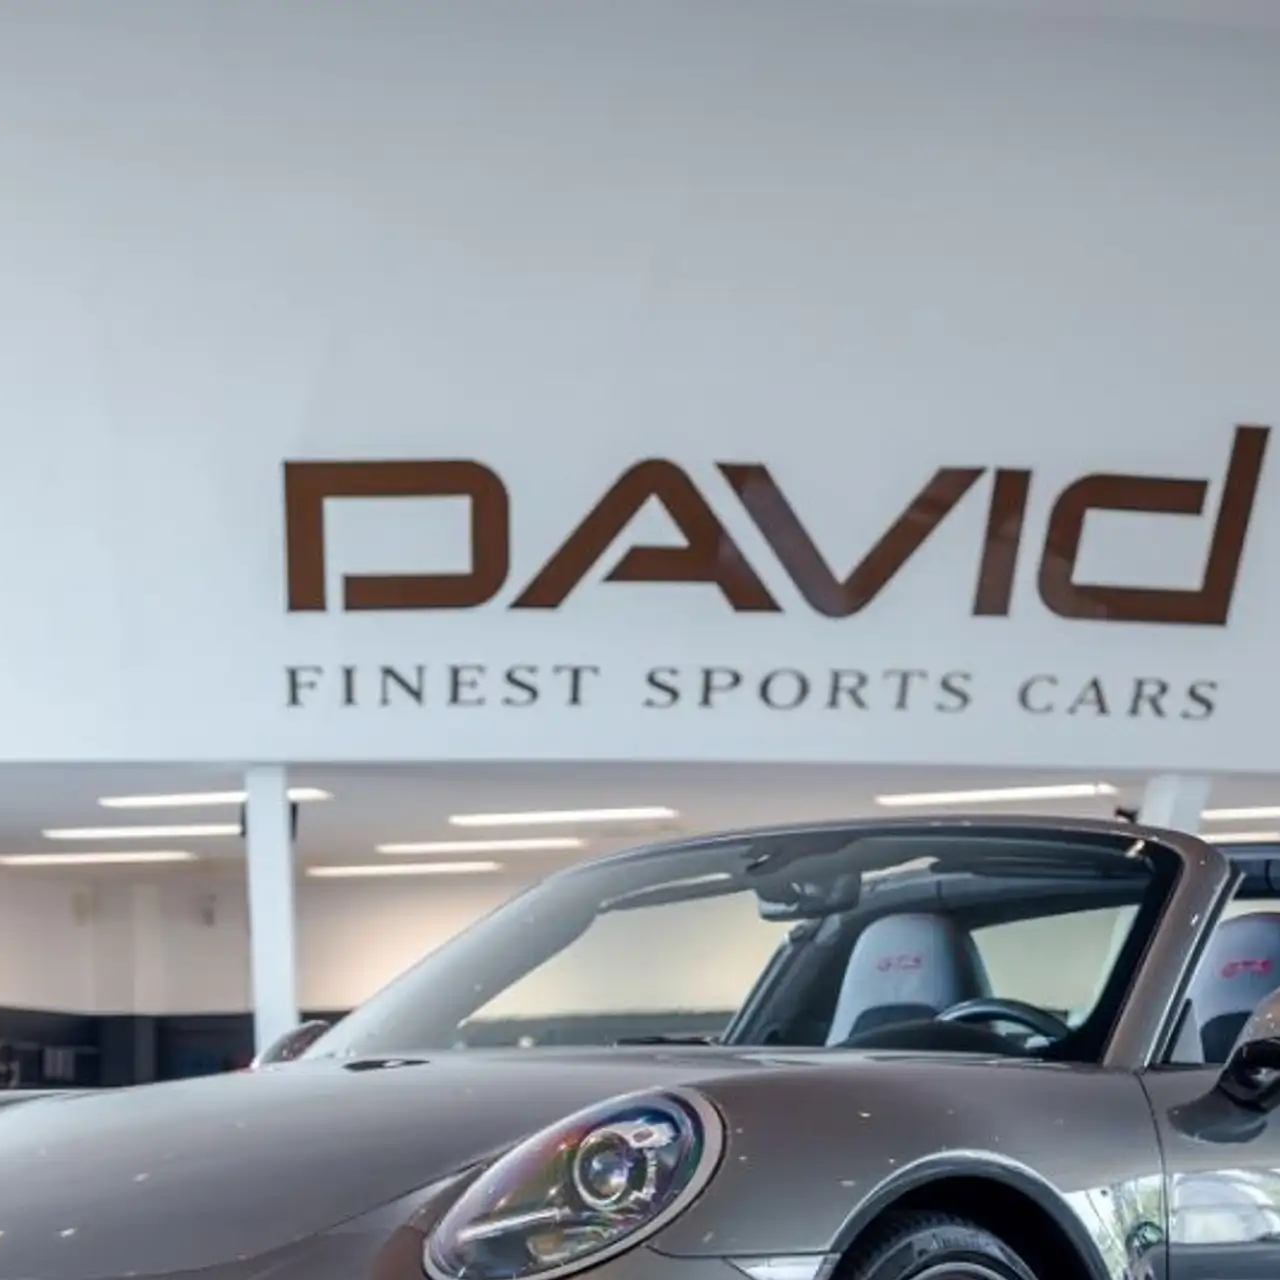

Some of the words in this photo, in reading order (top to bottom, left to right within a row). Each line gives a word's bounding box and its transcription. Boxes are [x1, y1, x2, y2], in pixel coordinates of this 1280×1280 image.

[285, 663, 600, 708] FINEST
[643, 666, 972, 713] SPORTS
[1017, 675, 1219, 720] CARS
